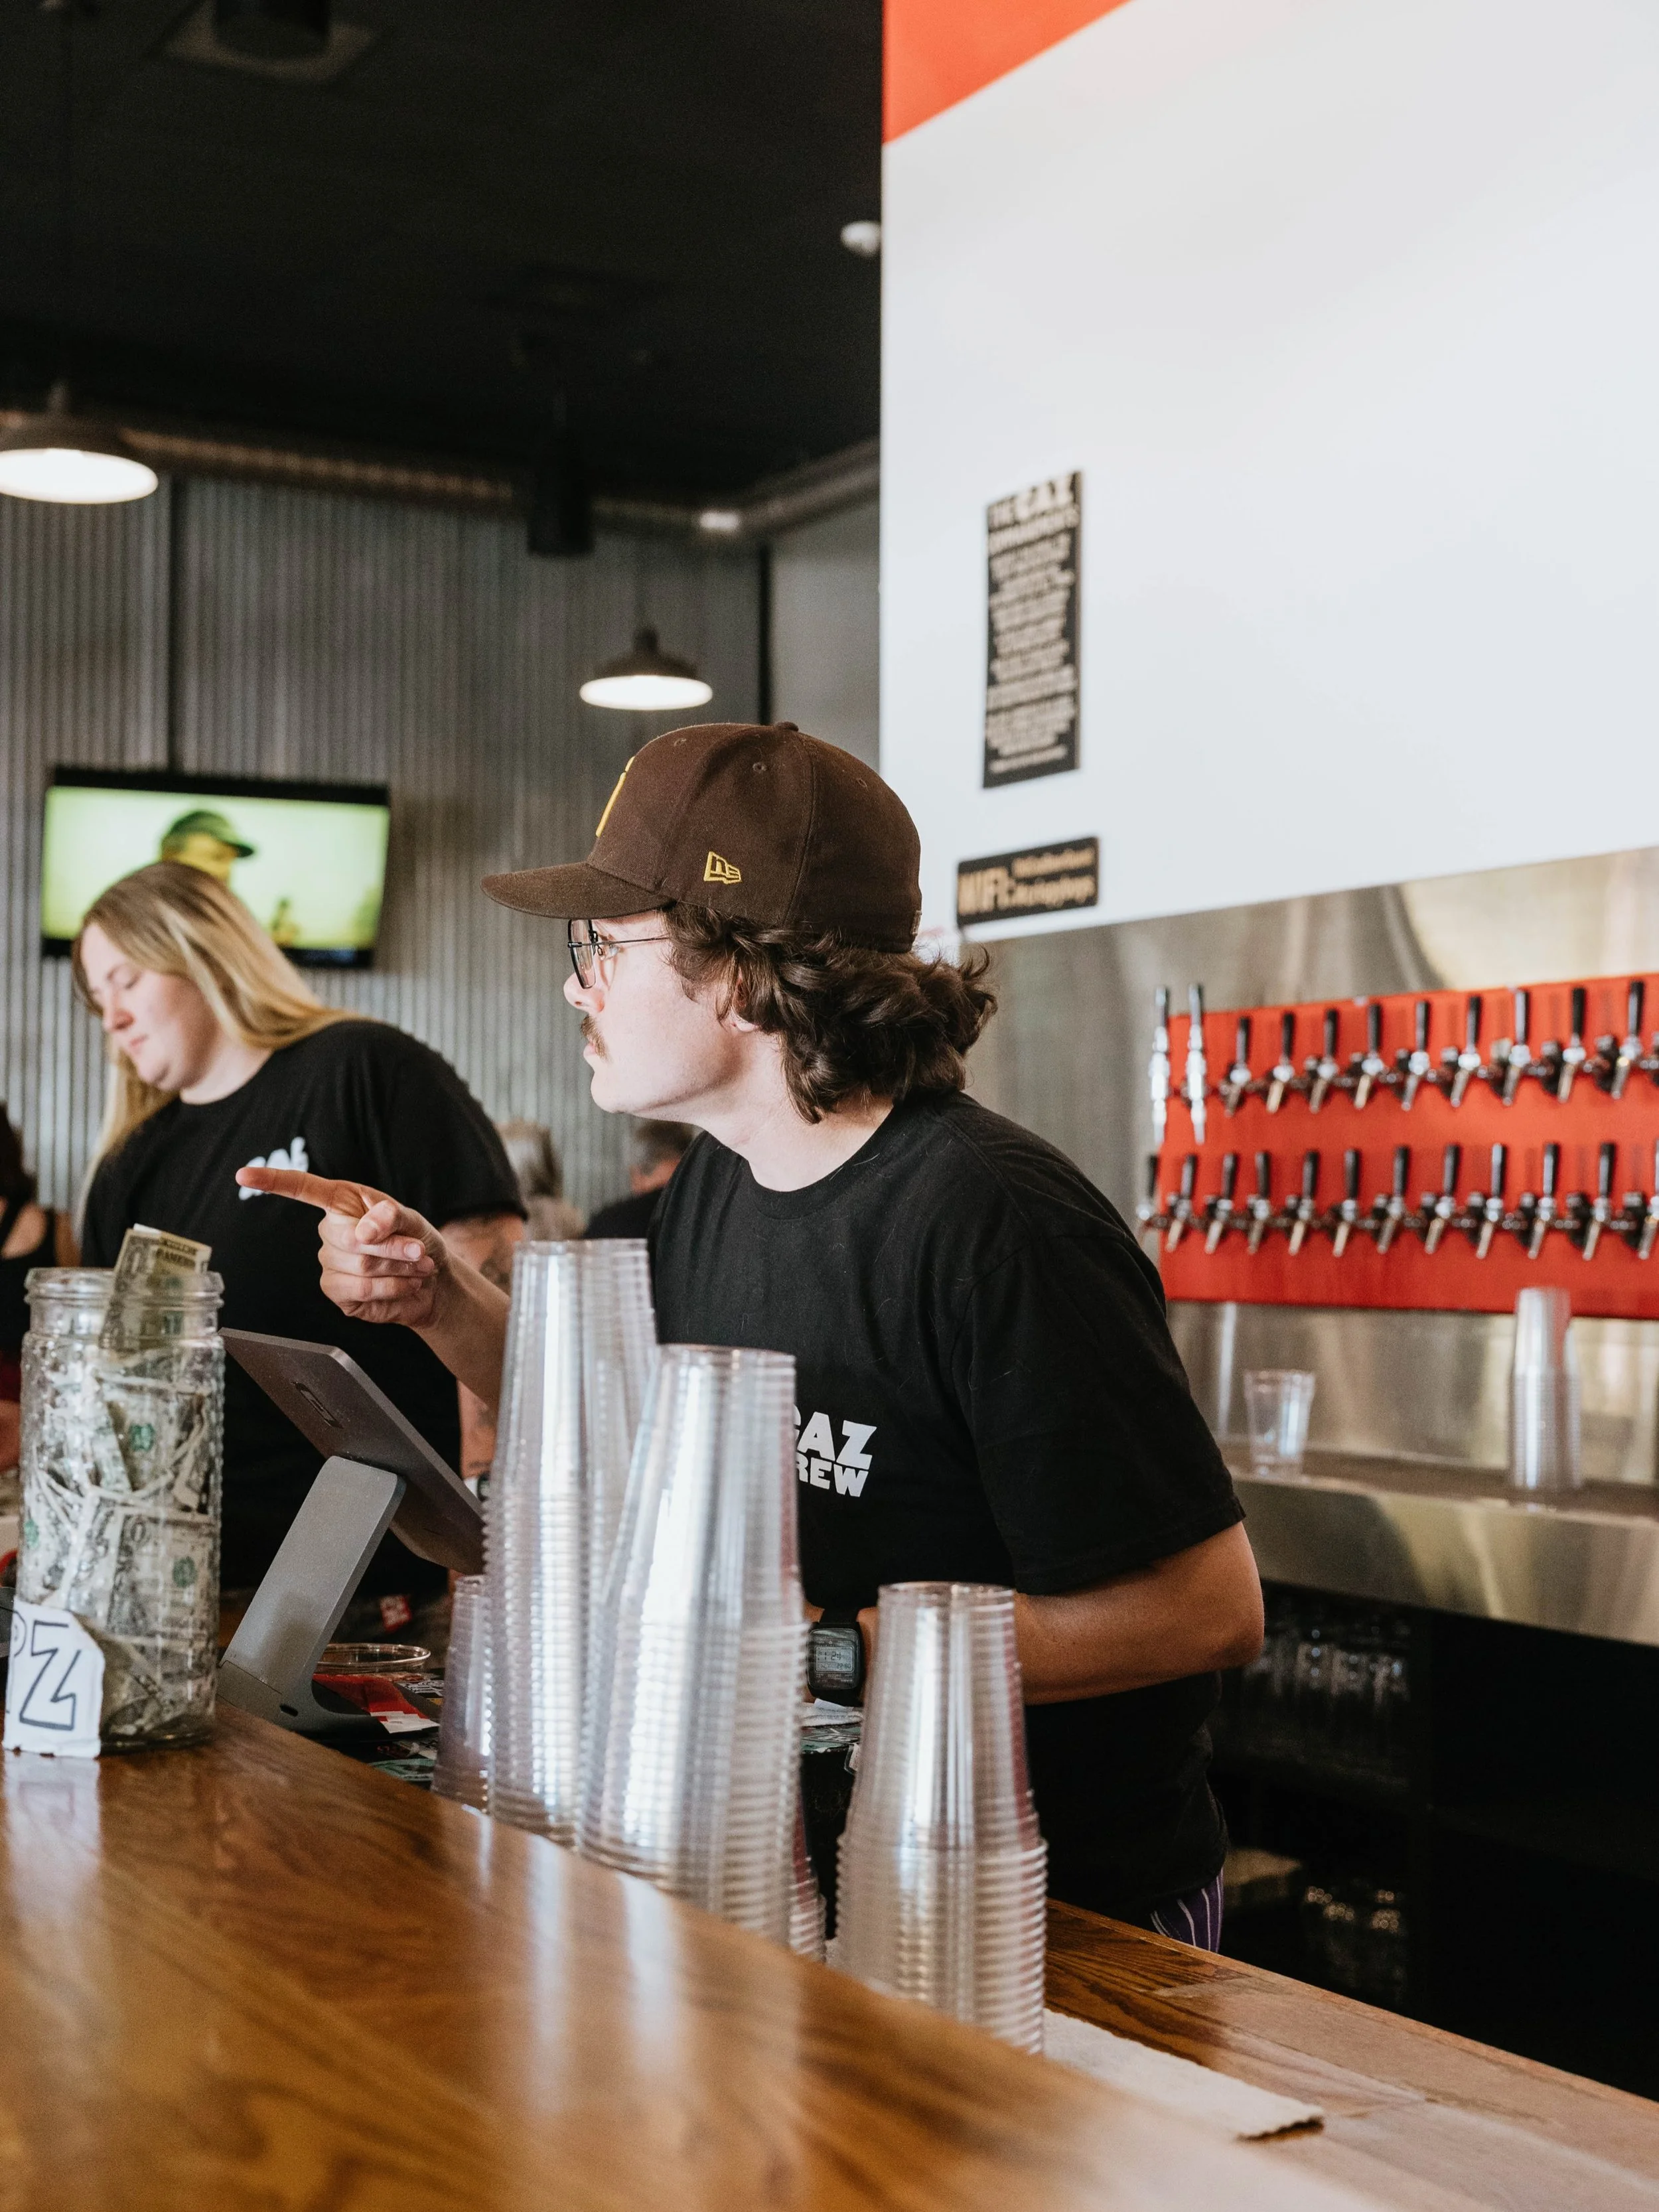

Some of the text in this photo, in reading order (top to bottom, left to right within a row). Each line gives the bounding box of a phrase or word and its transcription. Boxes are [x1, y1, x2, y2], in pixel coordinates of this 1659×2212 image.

[794, 1404, 877, 1470] AZ
[794, 1452, 869, 1497] REW
[13, 1611, 82, 1732] Z
